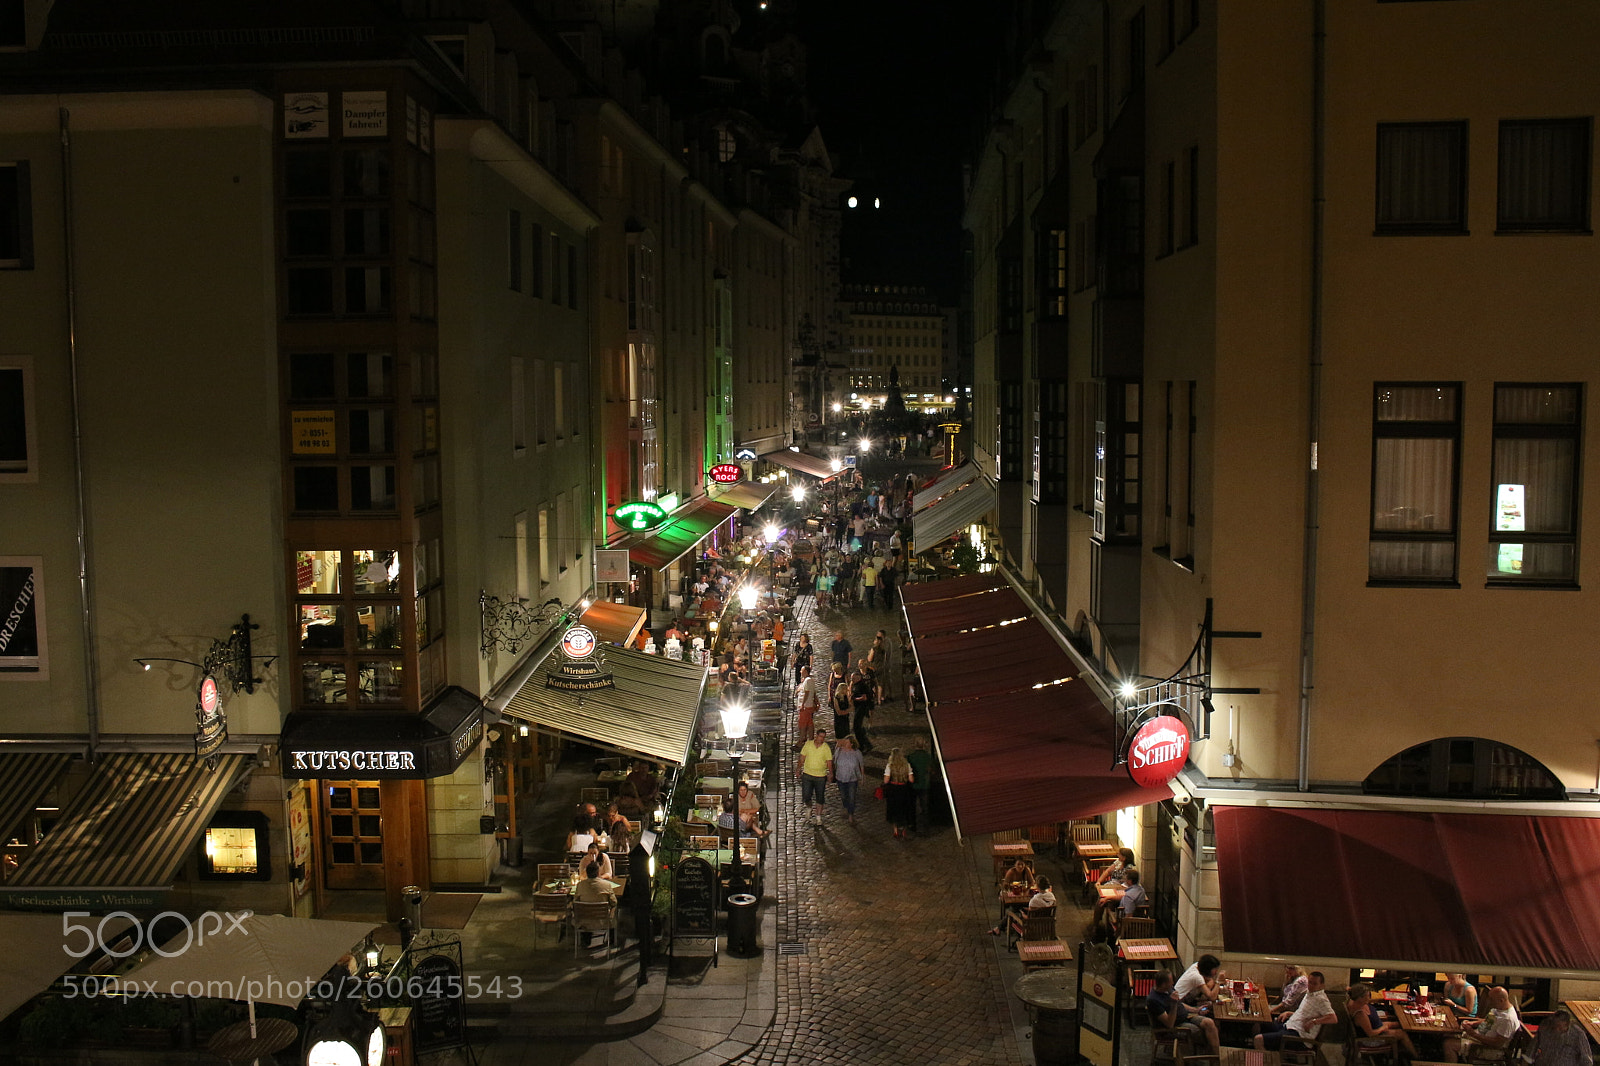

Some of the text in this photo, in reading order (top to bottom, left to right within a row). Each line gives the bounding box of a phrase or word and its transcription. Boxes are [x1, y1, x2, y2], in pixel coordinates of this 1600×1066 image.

[345, 110, 387, 120] Dampfer
[349, 120, 383, 129] fahren!
[712, 465, 738, 475] AYERS
[563, 666, 597, 675] Wirtshaus
[548, 677, 612, 690] Kutscherschänke
[1133, 734, 1186, 769] SCHIFF
[291, 751, 416, 771] KUTSCHER
